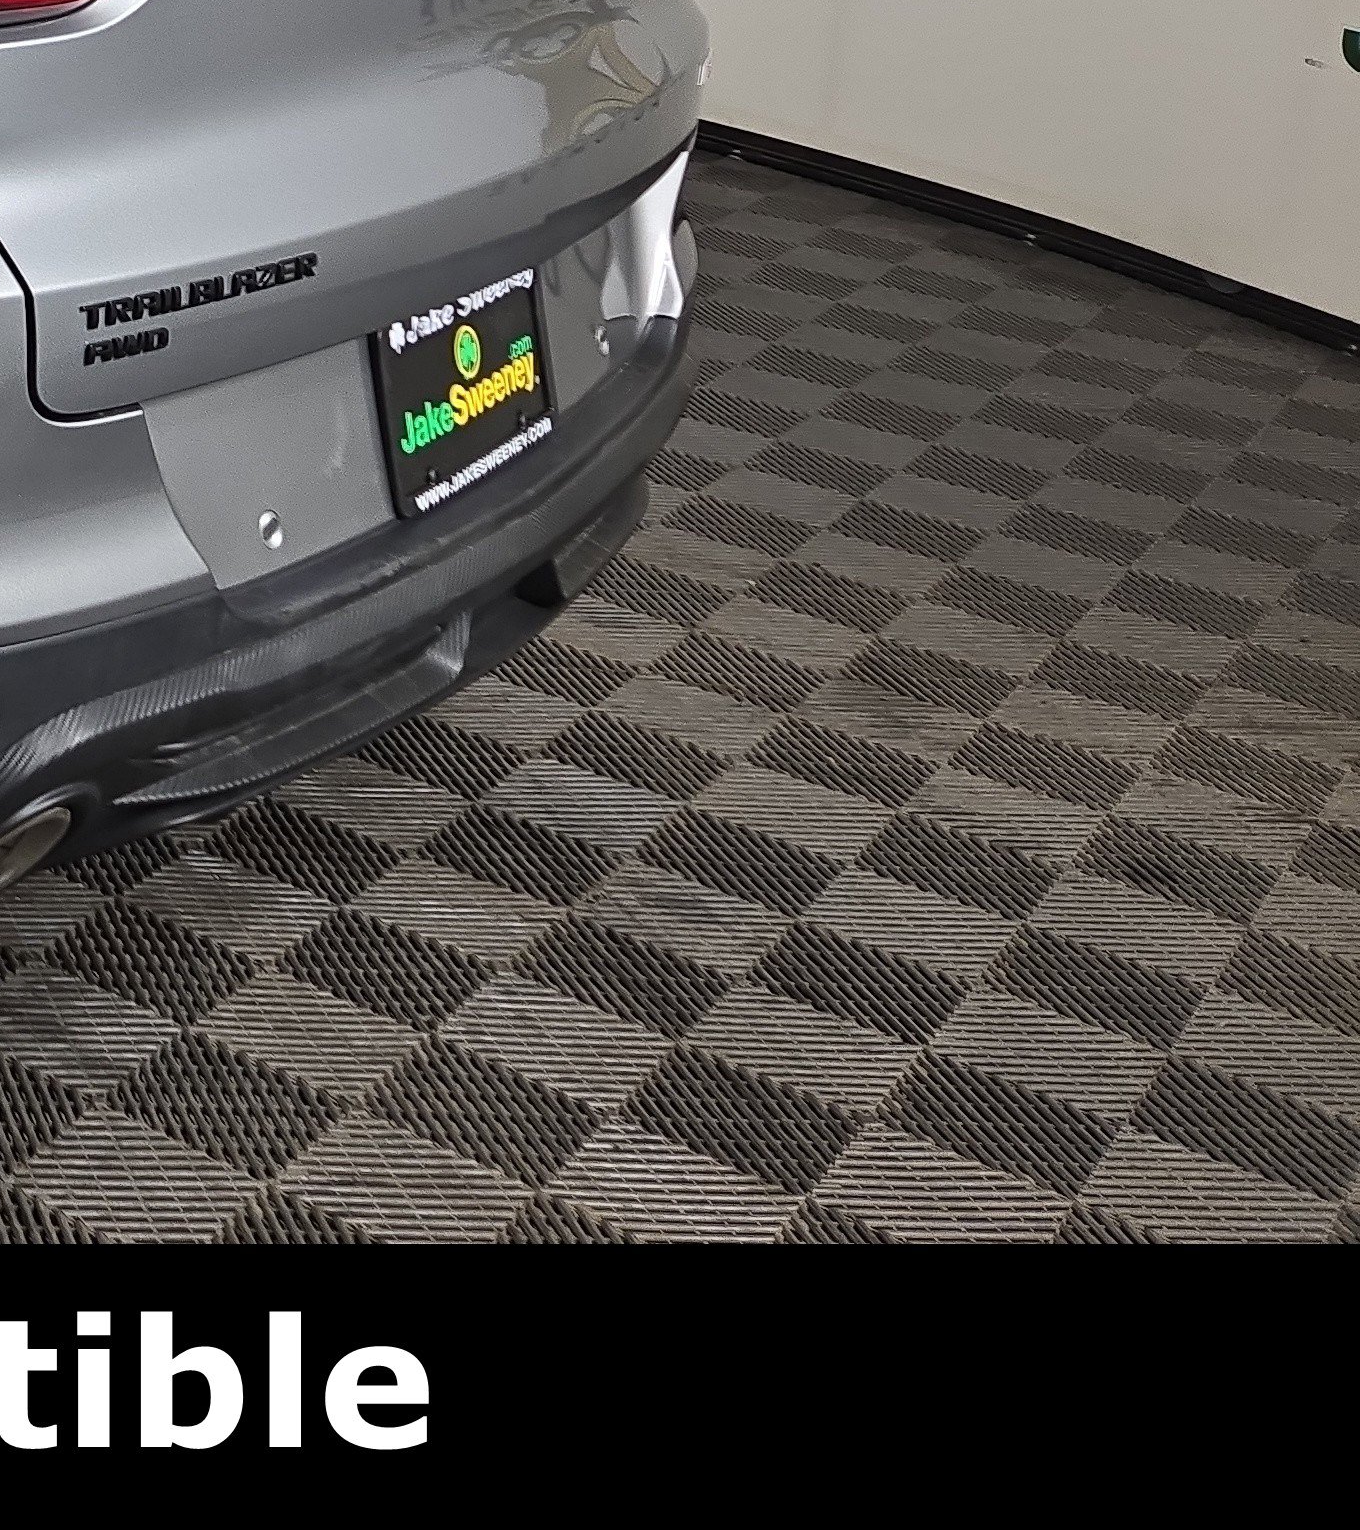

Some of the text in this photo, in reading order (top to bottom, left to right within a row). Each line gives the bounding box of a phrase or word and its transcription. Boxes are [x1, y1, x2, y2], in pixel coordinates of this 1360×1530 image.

[78, 252, 320, 330] TRAILBLAZER
[82, 327, 170, 367] AWD
[406, 304, 454, 344] Jake
[414, 416, 553, 512] WWW.JAKESWEENEY.COM
